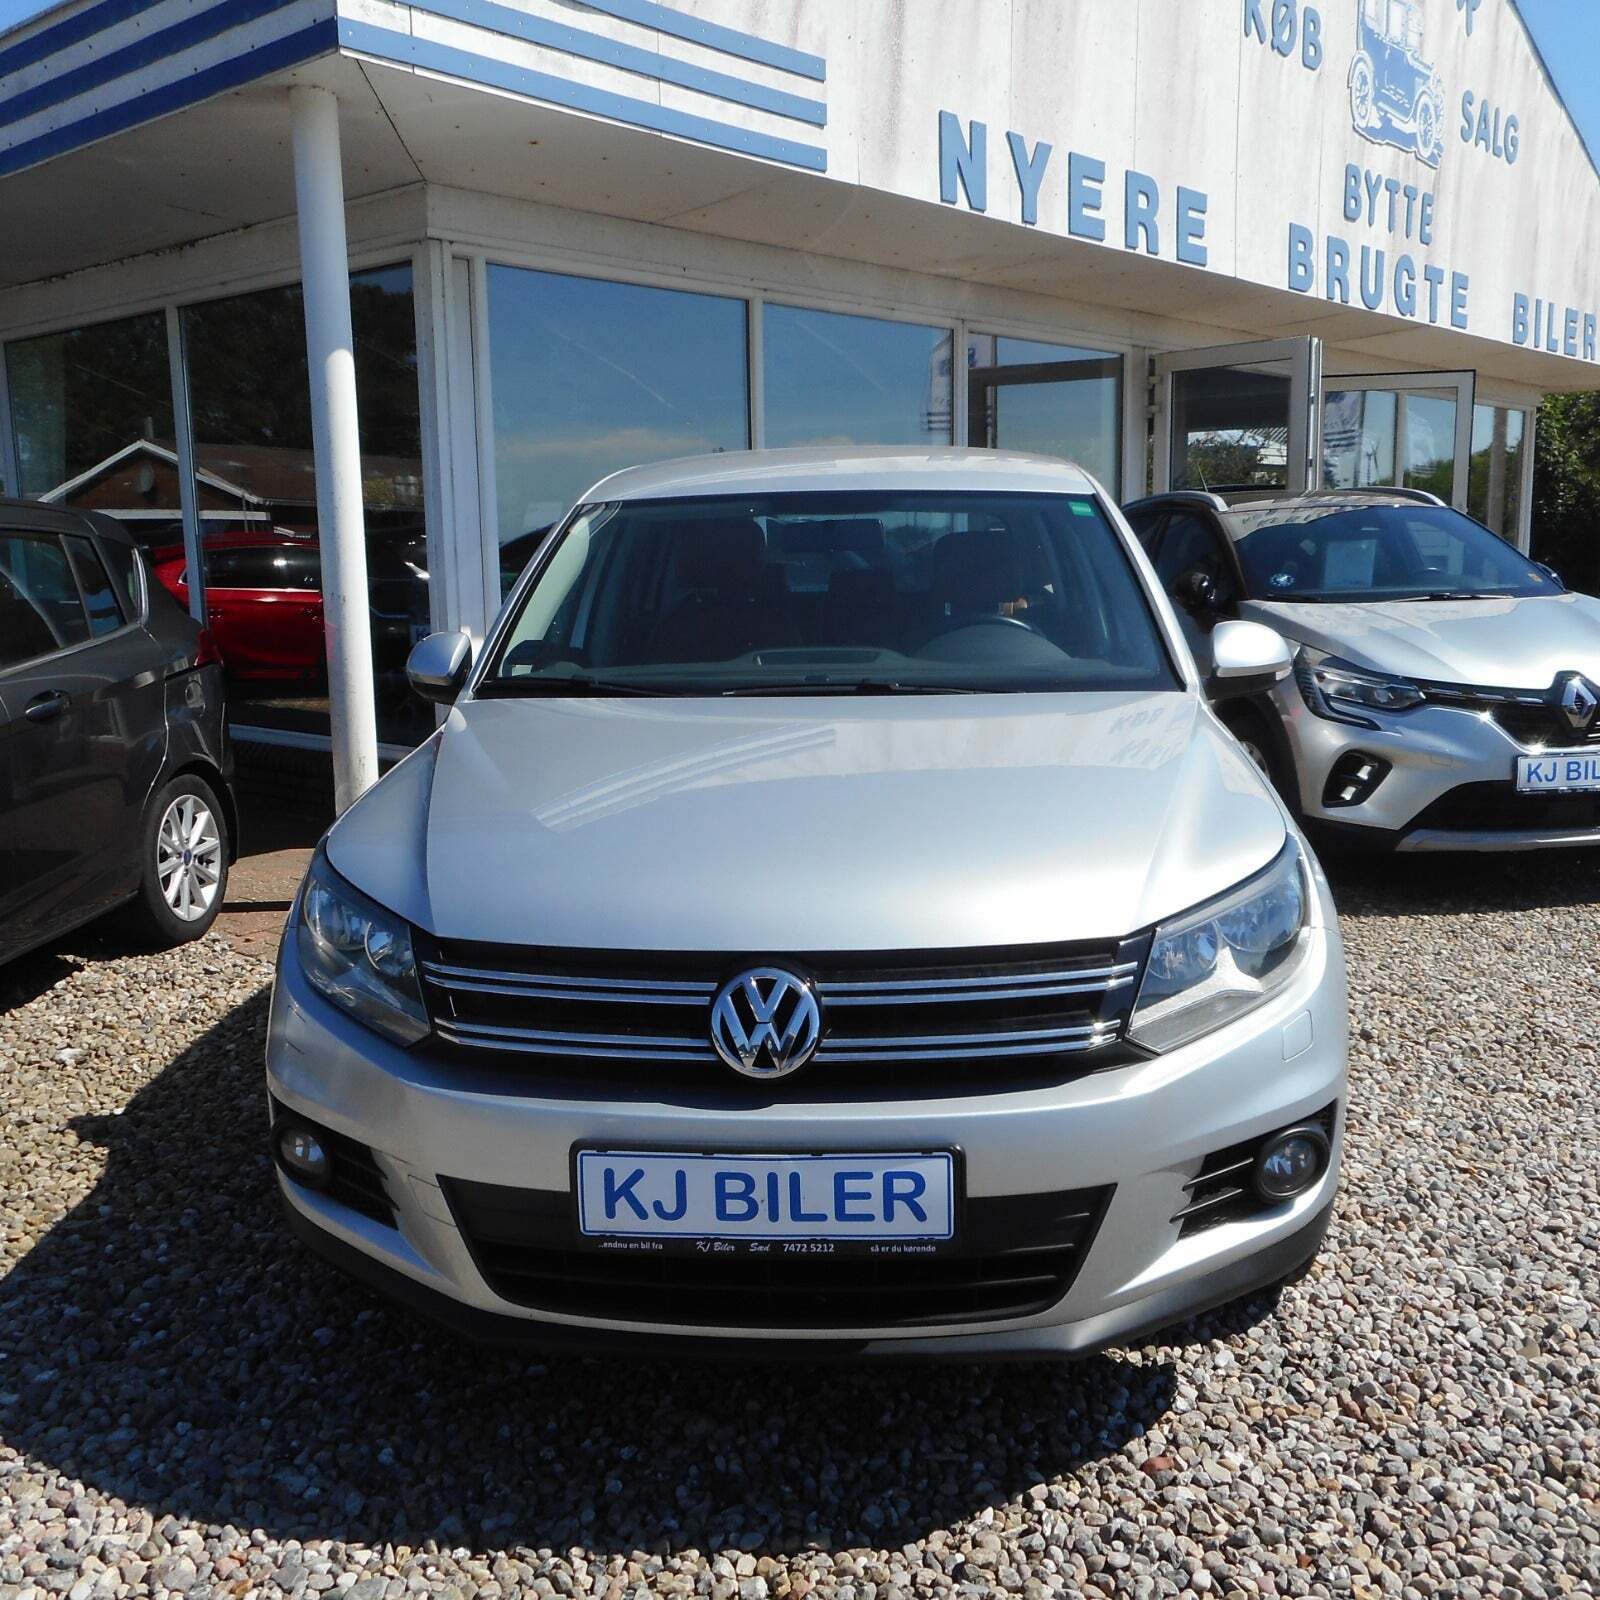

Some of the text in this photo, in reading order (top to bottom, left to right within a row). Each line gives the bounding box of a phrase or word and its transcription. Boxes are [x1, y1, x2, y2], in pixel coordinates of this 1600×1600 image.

[1460, 90, 1520, 165] SALG
[1344, 162, 1434, 246] BYTTE
[938, 109, 1597, 361] NYERE BRUGTE BILER
[1527, 762, 1557, 783] KJ
[603, 1167, 928, 1223] KJ BILER
[641, 1241, 650, 1249] bil
[651, 1242, 663, 1250] fra
[696, 1241, 711, 1252] KJ
[713, 1241, 735, 1252] Biler
[783, 1243, 835, 1252] 7472 5212
[891, 1244, 902, 1252] du
